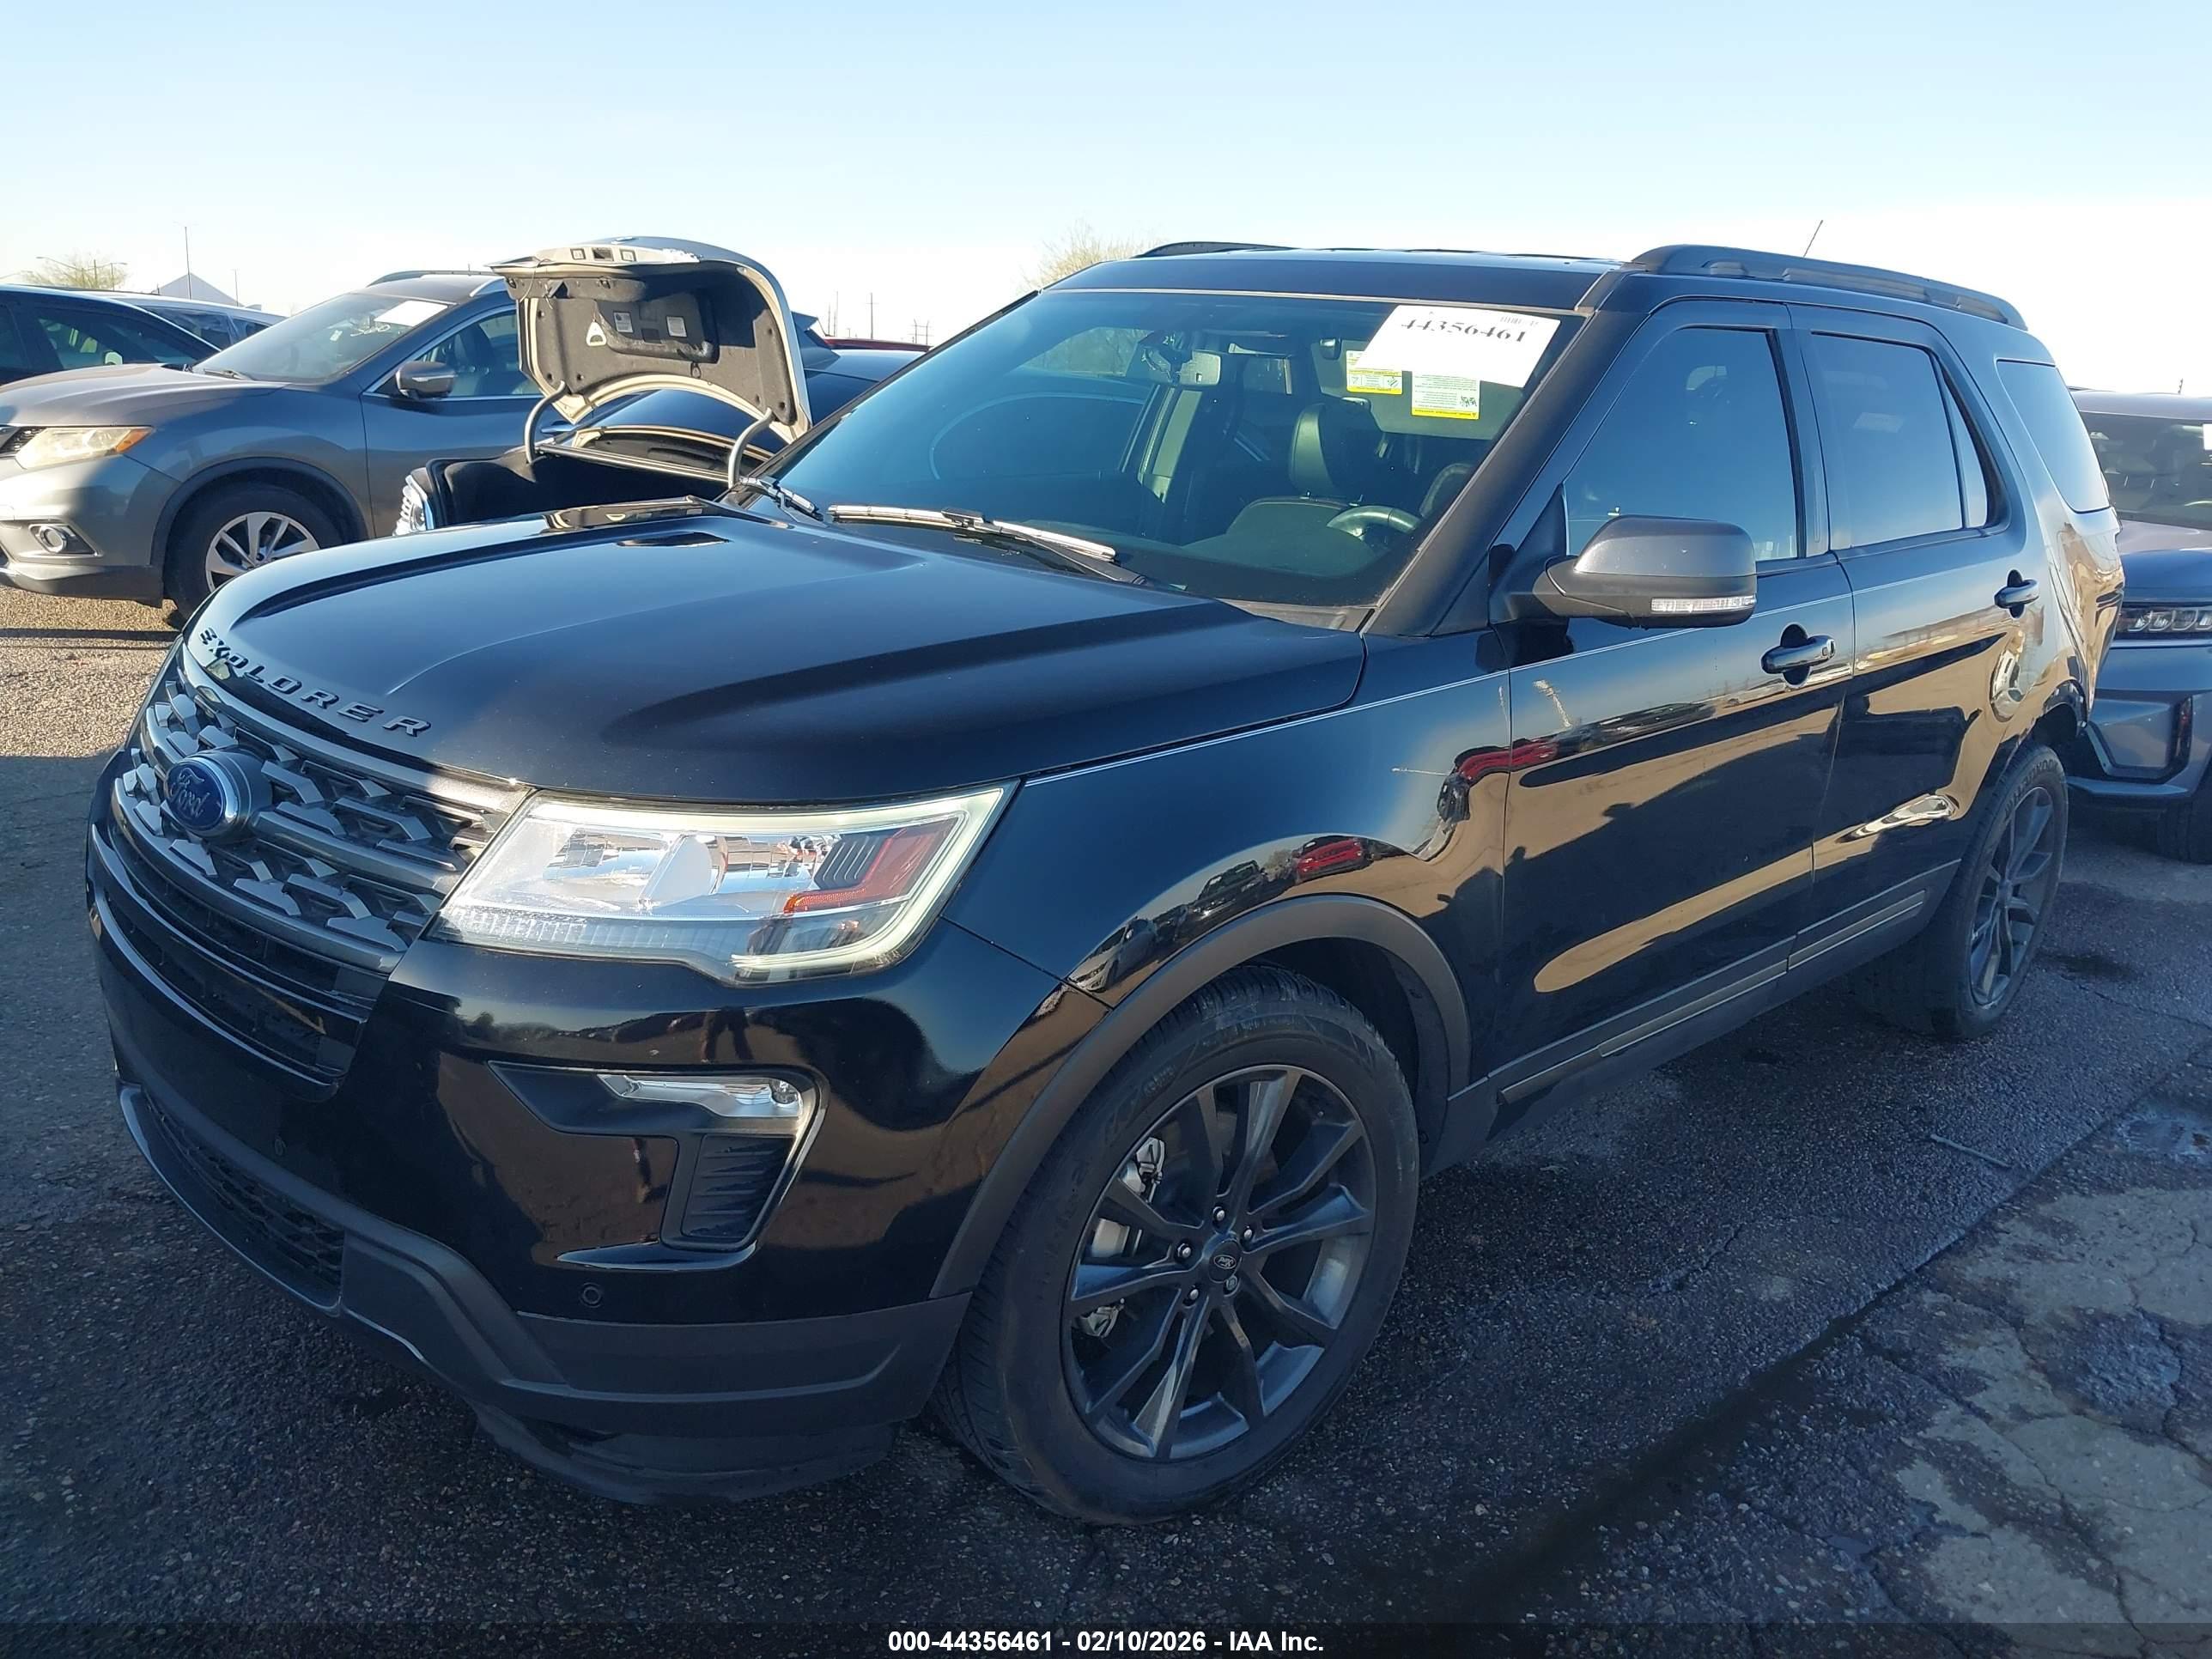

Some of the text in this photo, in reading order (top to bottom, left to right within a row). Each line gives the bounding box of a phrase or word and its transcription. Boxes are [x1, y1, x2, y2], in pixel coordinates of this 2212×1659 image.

[1401, 318, 1527, 343] 44356461
[198, 627, 432, 738] EXPLORER
[169, 766, 211, 820] Ford
